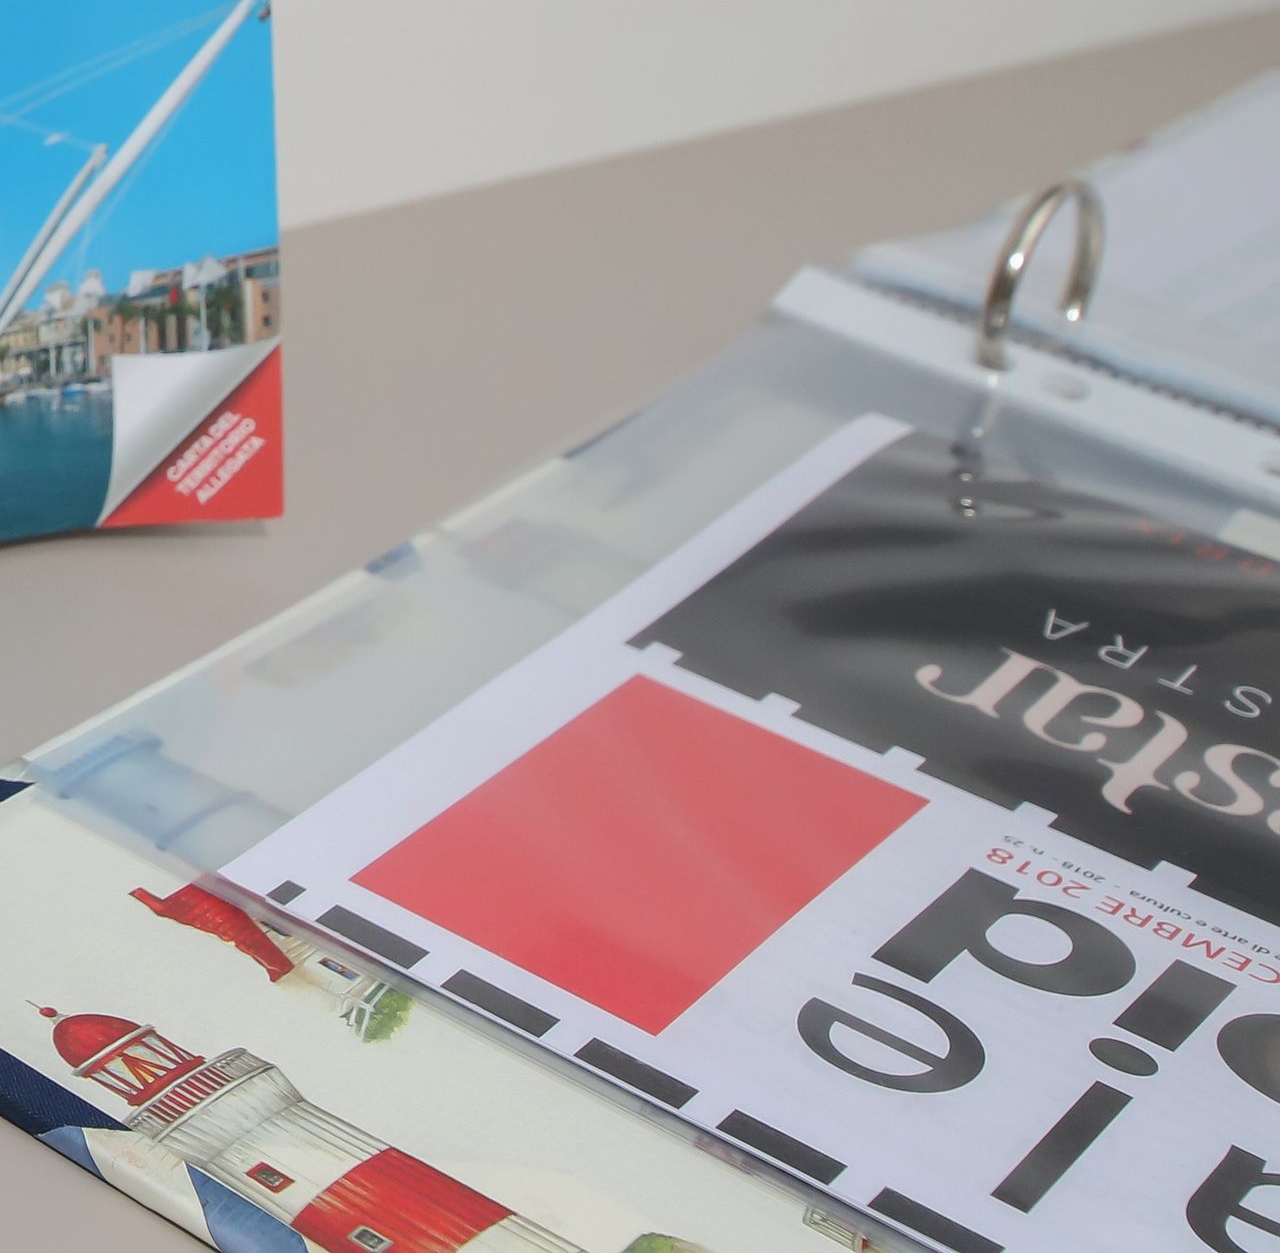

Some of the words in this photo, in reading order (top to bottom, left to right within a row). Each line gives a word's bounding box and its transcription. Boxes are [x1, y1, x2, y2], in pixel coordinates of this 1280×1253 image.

[986, 847, 1092, 899] 2018
[1061, 861, 1107, 884] 2018
[1129, 889, 1193, 921] cultura
[1095, 894, 1280, 983] CEMBRE
[1211, 925, 1249, 946] arte
[1251, 943, 1271, 955] di
